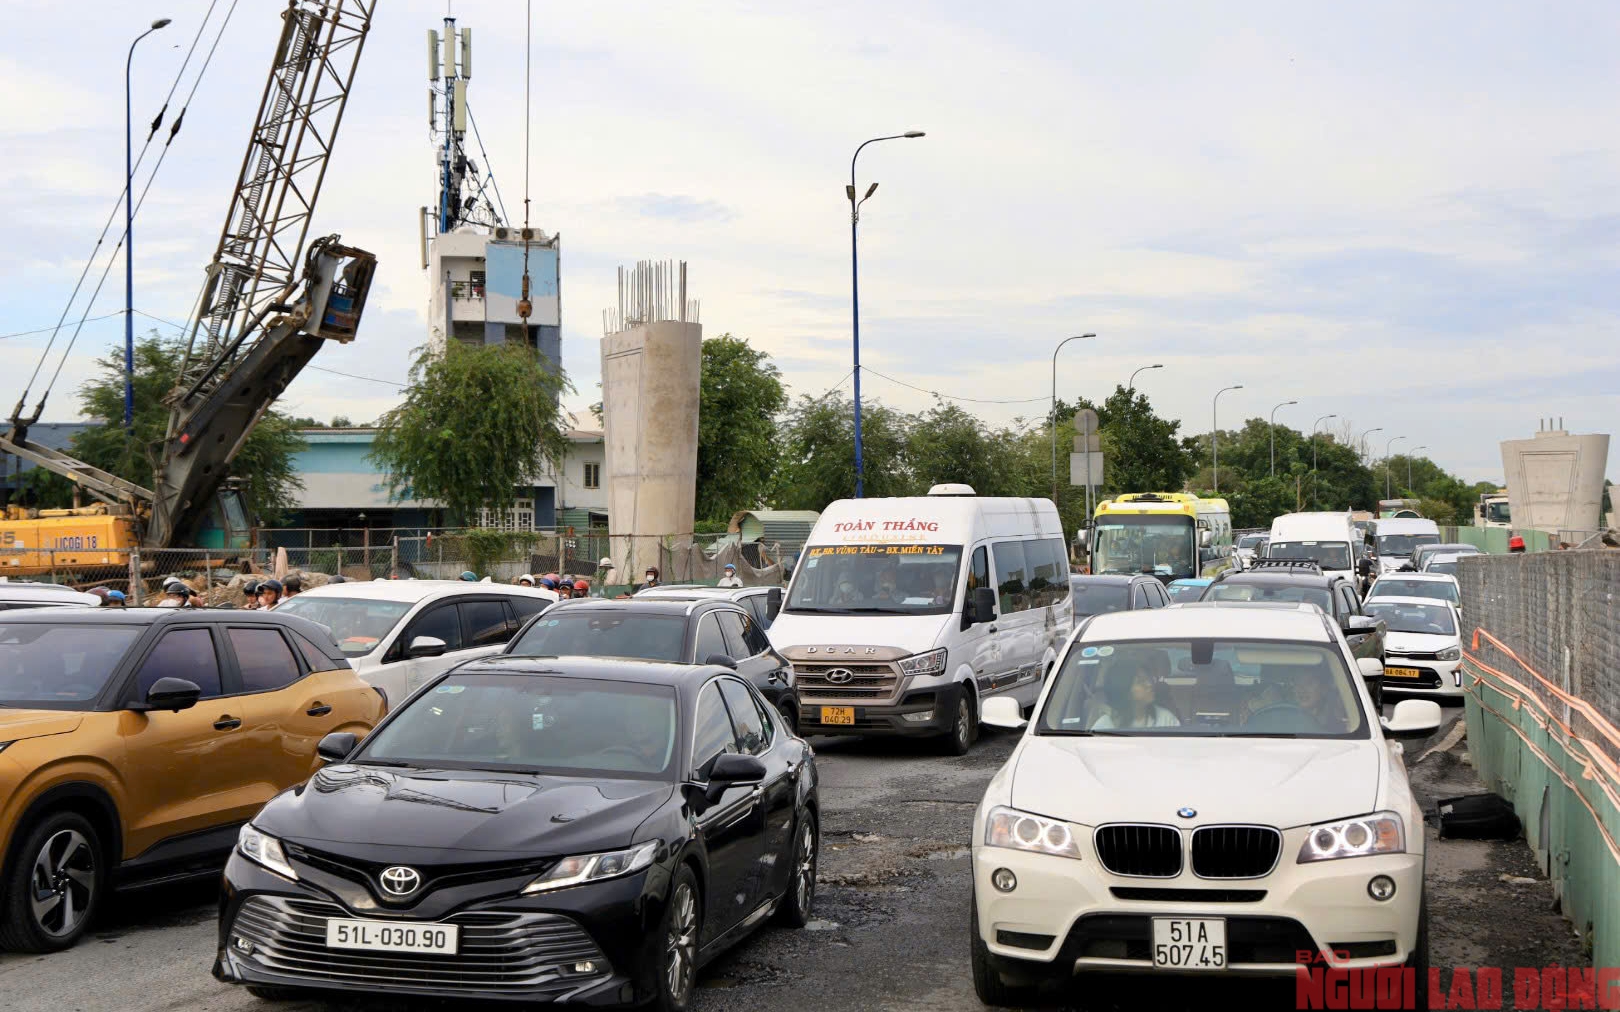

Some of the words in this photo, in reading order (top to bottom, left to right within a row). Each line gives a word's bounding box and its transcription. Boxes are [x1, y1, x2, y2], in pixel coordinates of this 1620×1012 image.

[883, 517, 939, 532] THẮNG
[87, 535, 97, 549] 18
[807, 646, 876, 655] DCAR
[831, 707, 845, 716] 72H
[337, 925, 446, 949] 51L-030.90
[1170, 921, 1208, 943] 51A
[1156, 944, 1224, 967] 507.45
